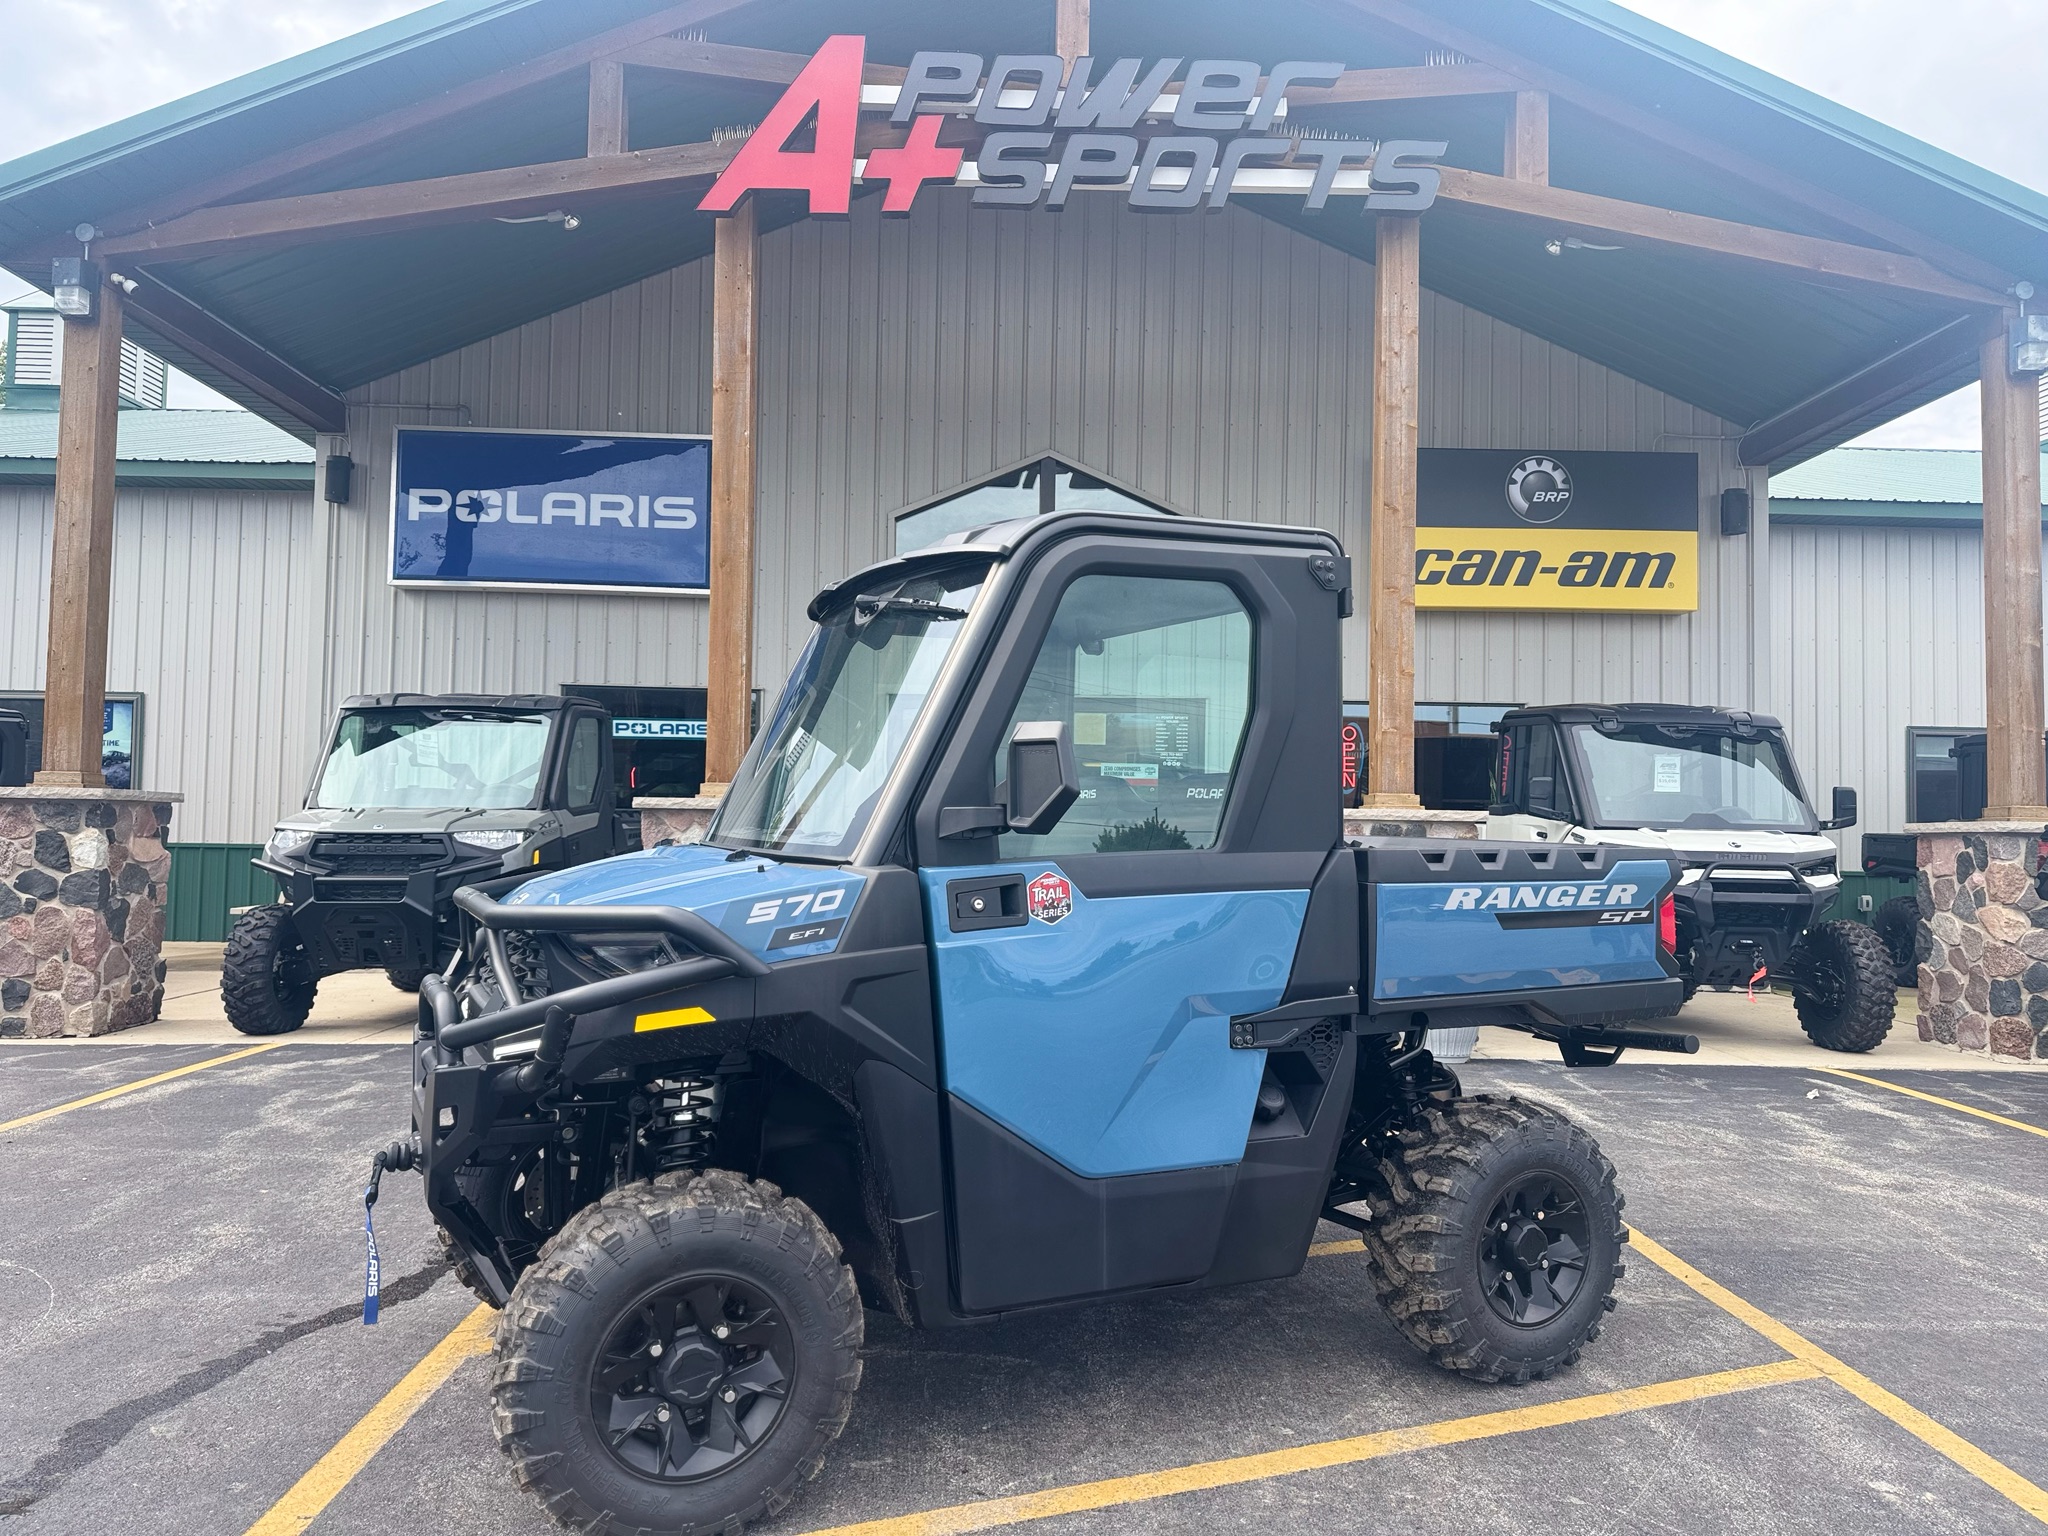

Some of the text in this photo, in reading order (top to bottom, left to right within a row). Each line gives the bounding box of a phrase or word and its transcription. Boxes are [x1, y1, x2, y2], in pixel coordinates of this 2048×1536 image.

[1532, 490, 1570, 503] BRP
[407, 488, 697, 530] POLARIS
[614, 722, 707, 736] POLARIS
[1341, 726, 1357, 787] OPEN
[540, 819, 556, 830] XP
[1032, 886, 1067, 903] TRAIL
[1443, 884, 1638, 911] RANGER
[745, 888, 845, 925] 570
[1038, 907, 1068, 919] SERIES
[1598, 911, 1650, 924] SP
[788, 927, 826, 941] EFI
[366, 1230, 379, 1297] POLARIS
